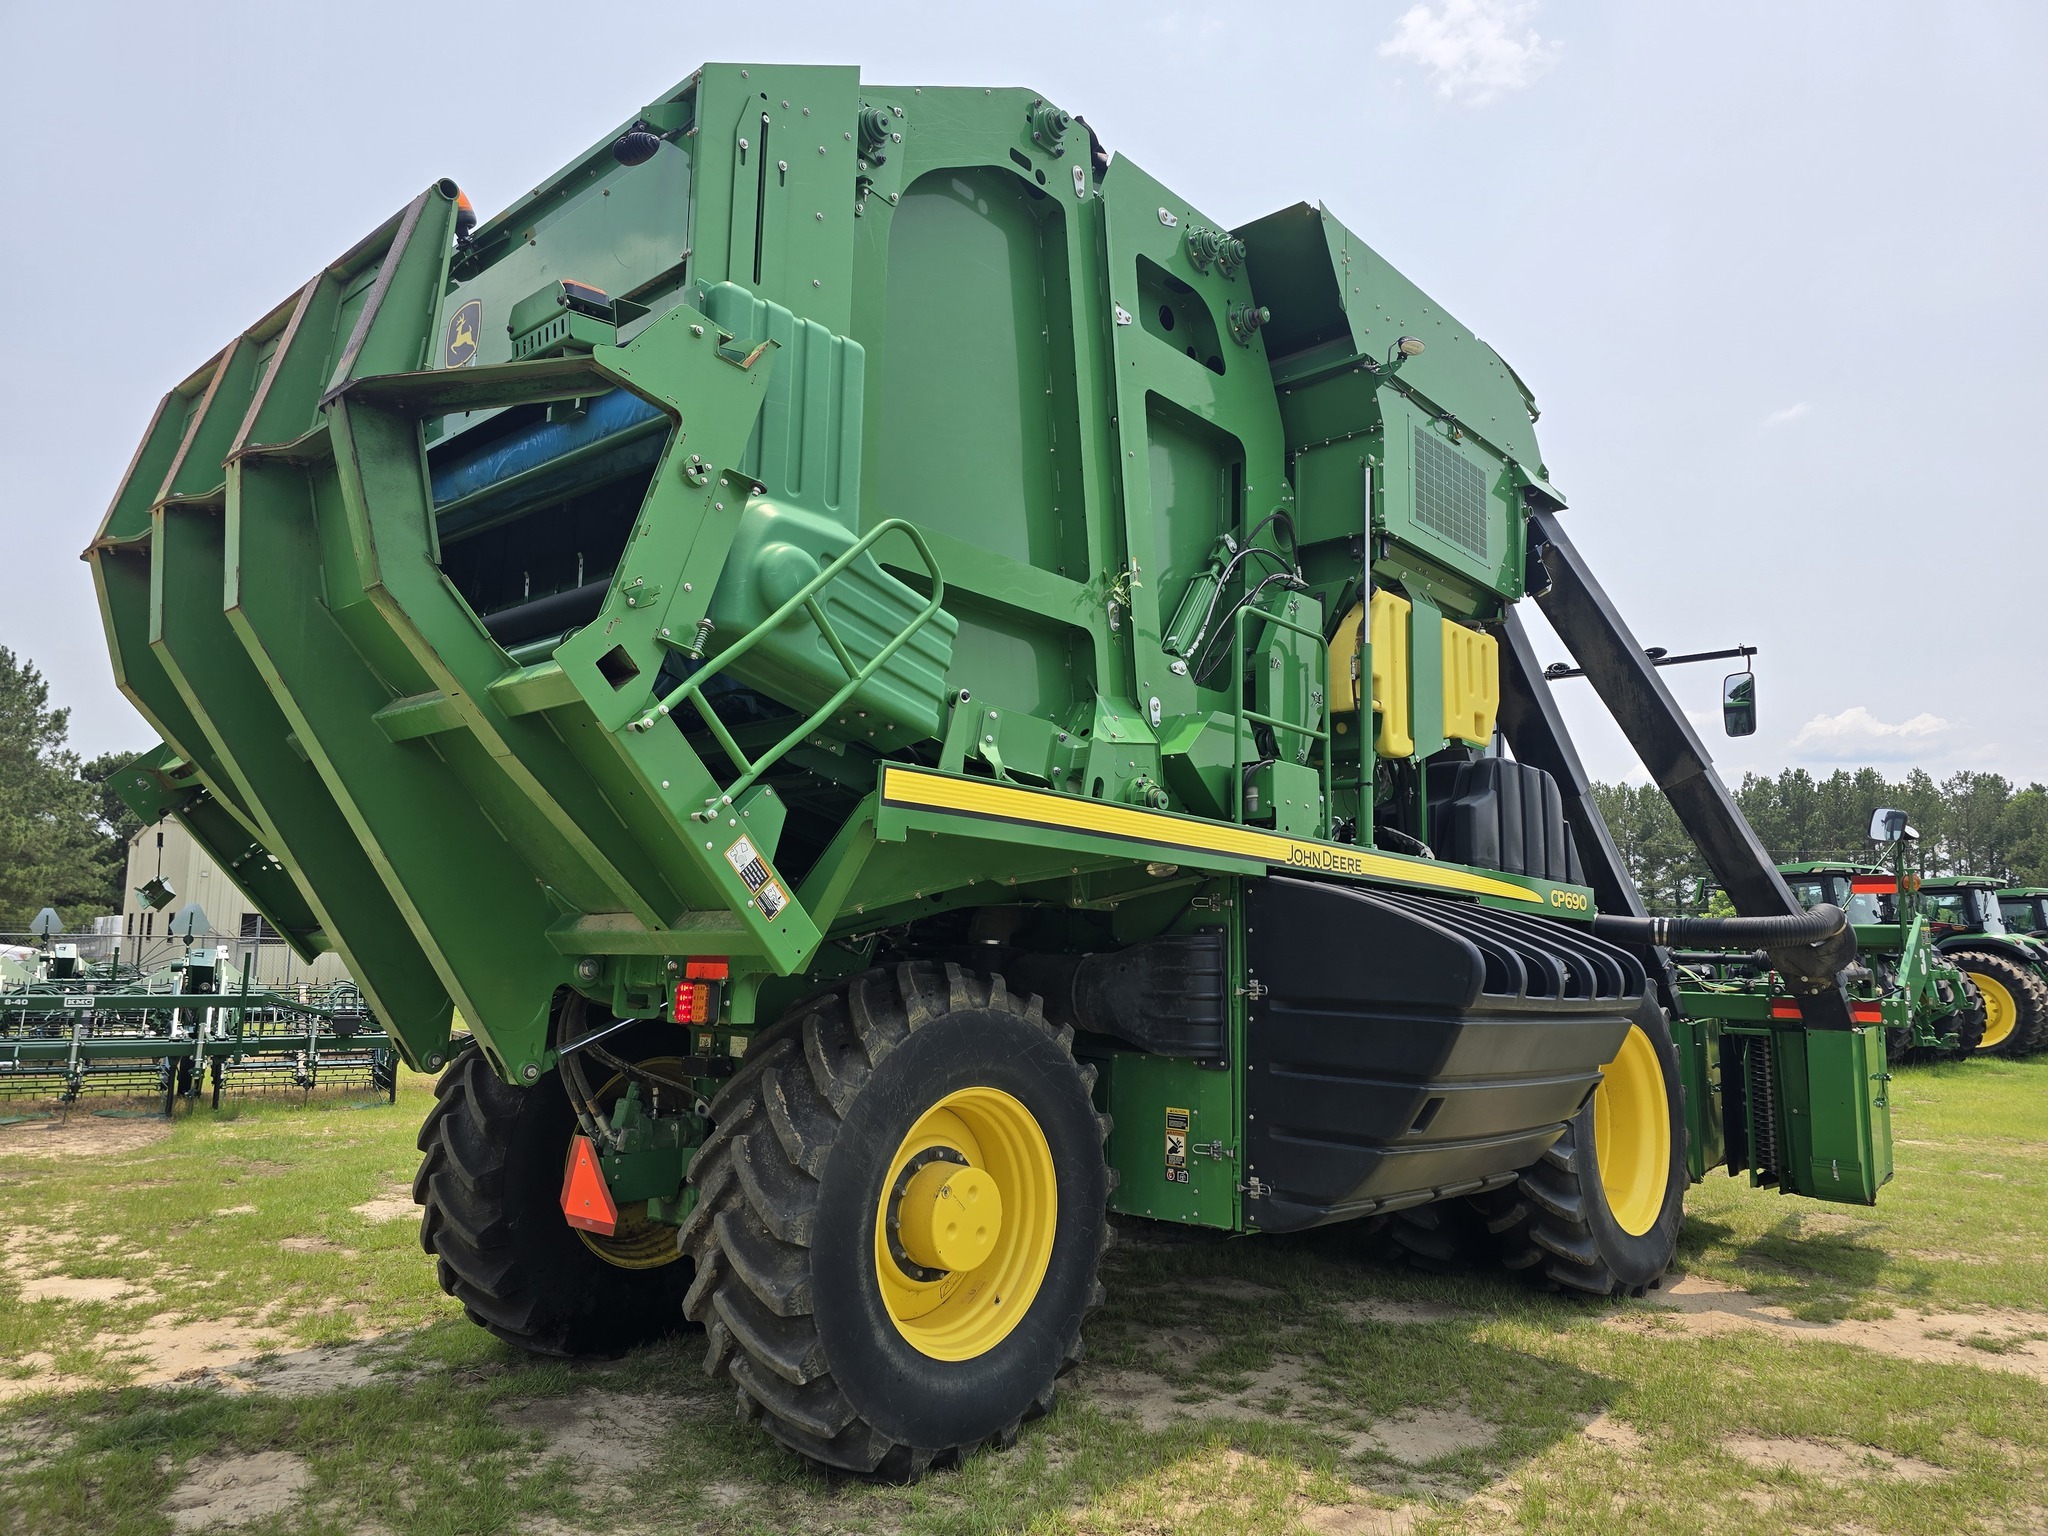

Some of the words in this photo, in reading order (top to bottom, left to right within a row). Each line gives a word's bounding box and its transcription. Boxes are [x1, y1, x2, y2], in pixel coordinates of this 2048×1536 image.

[1287, 845, 1321, 867] JOHN
[1323, 850, 1362, 873] DEERE
[1551, 889, 1588, 911] CP690
[1919, 948, 1927, 976] 3
[4, 998, 29, 1006] 8-40
